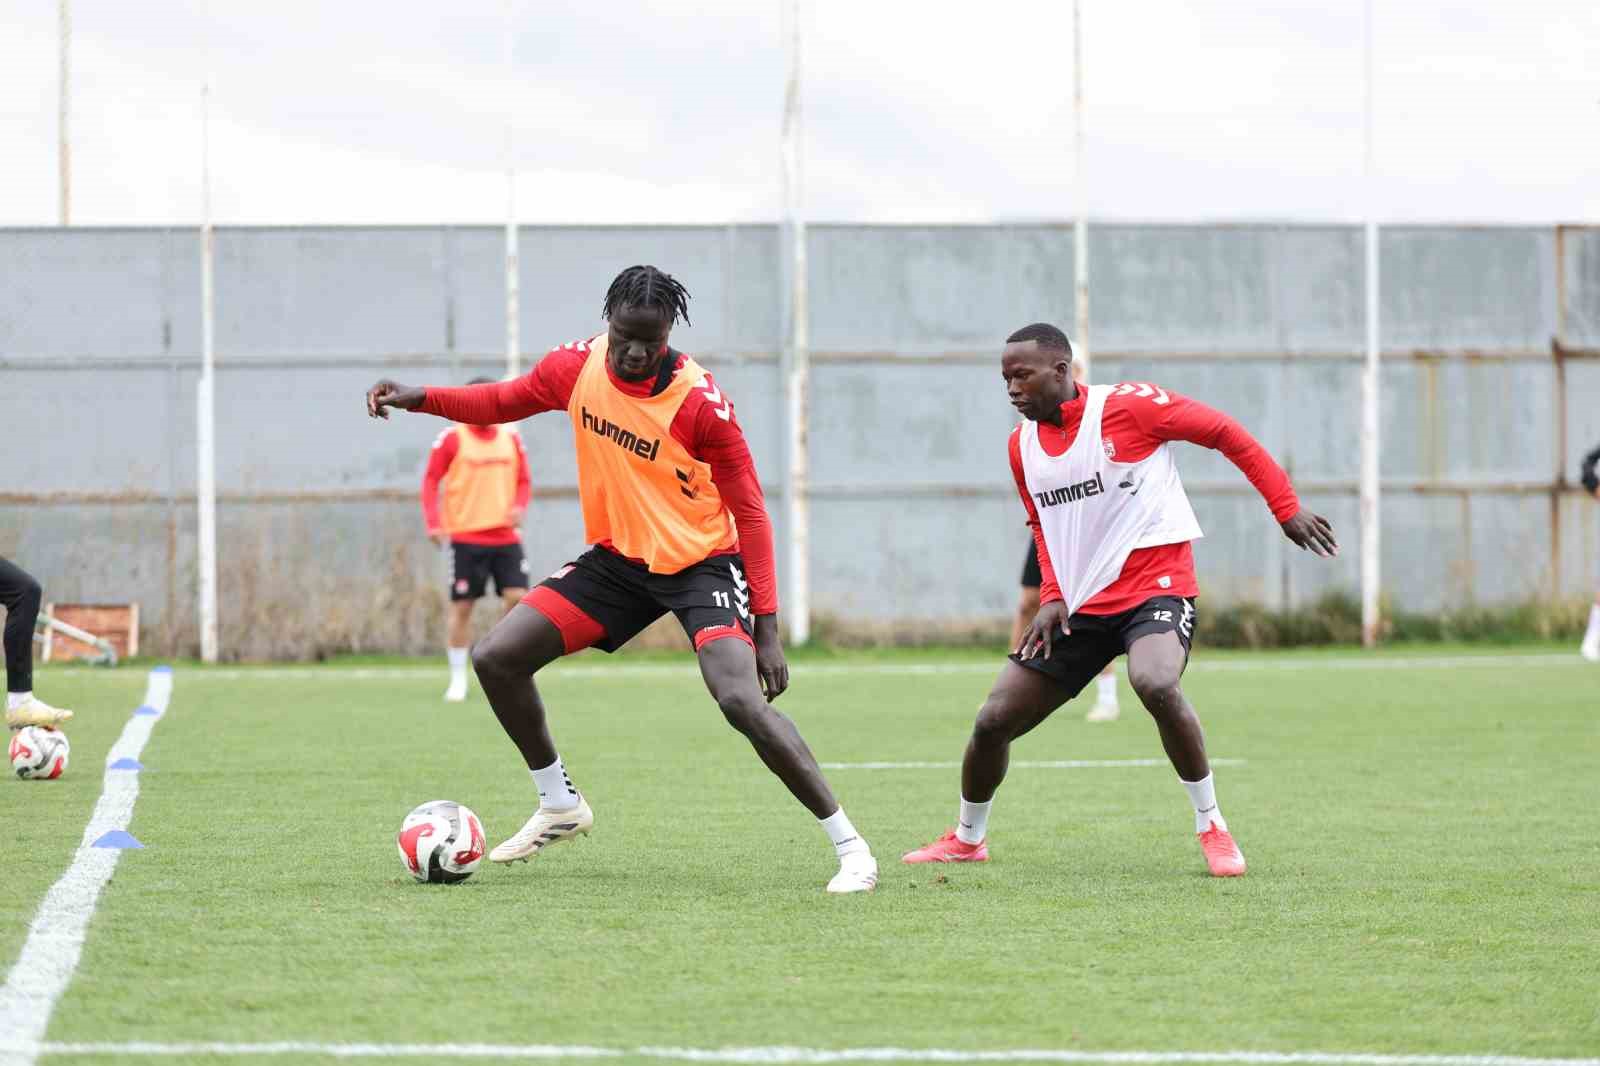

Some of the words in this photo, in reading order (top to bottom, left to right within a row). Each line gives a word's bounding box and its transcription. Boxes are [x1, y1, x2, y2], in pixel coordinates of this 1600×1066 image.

[582, 406, 660, 462] hummel
[712, 591, 730, 609] 11
[1153, 610, 1172, 622] 12
